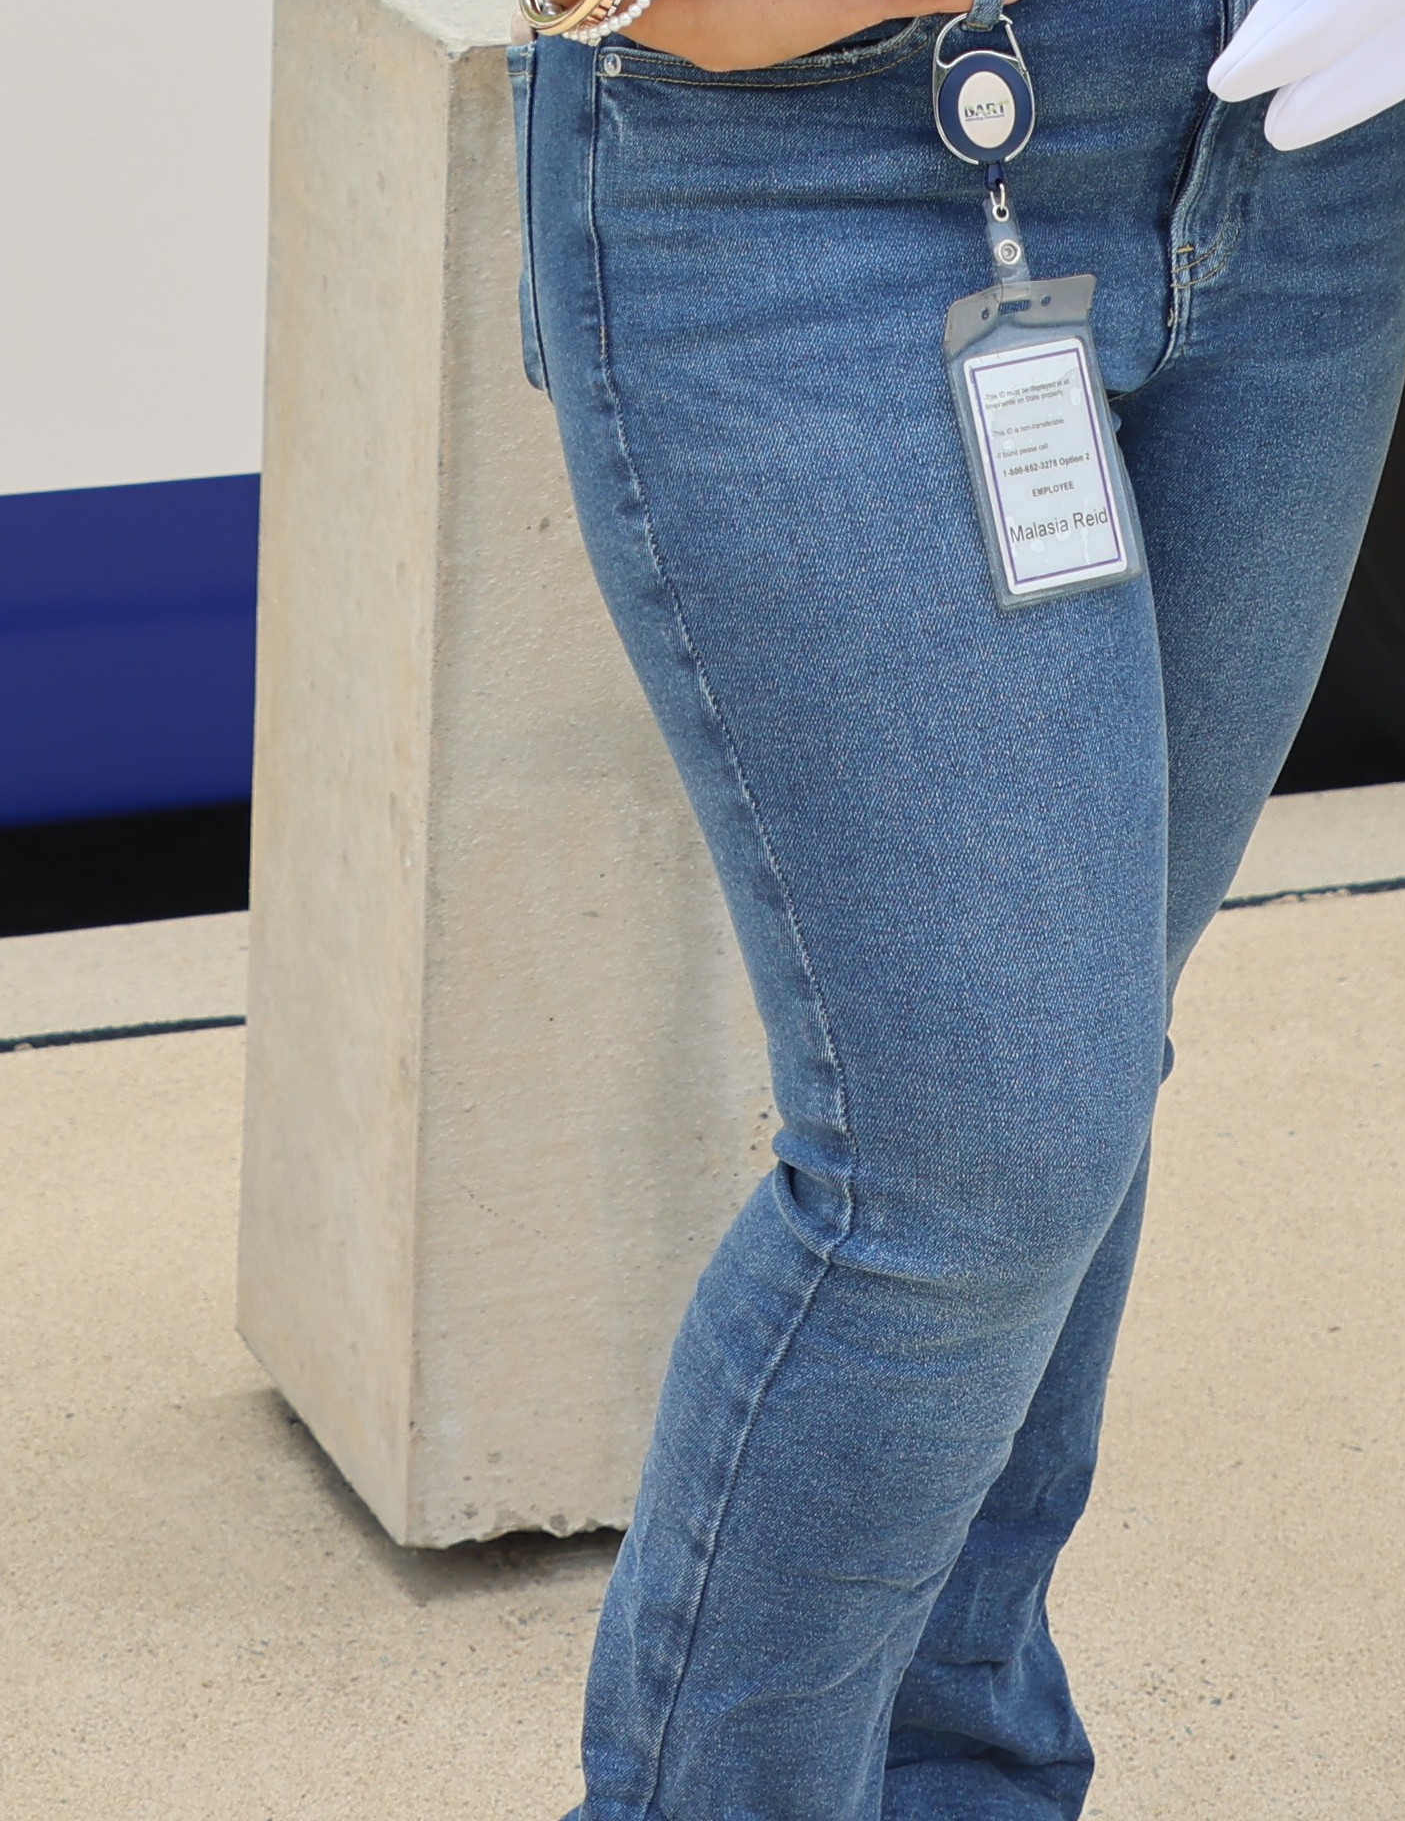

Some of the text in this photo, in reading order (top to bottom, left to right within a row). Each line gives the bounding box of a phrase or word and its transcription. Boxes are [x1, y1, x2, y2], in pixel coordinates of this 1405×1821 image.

[1058, 455, 1084, 467] Option
[1085, 452, 1090, 460] 2
[1032, 481, 1075, 497] EMPLOYEE
[1009, 507, 1108, 543] Malasia Reid
